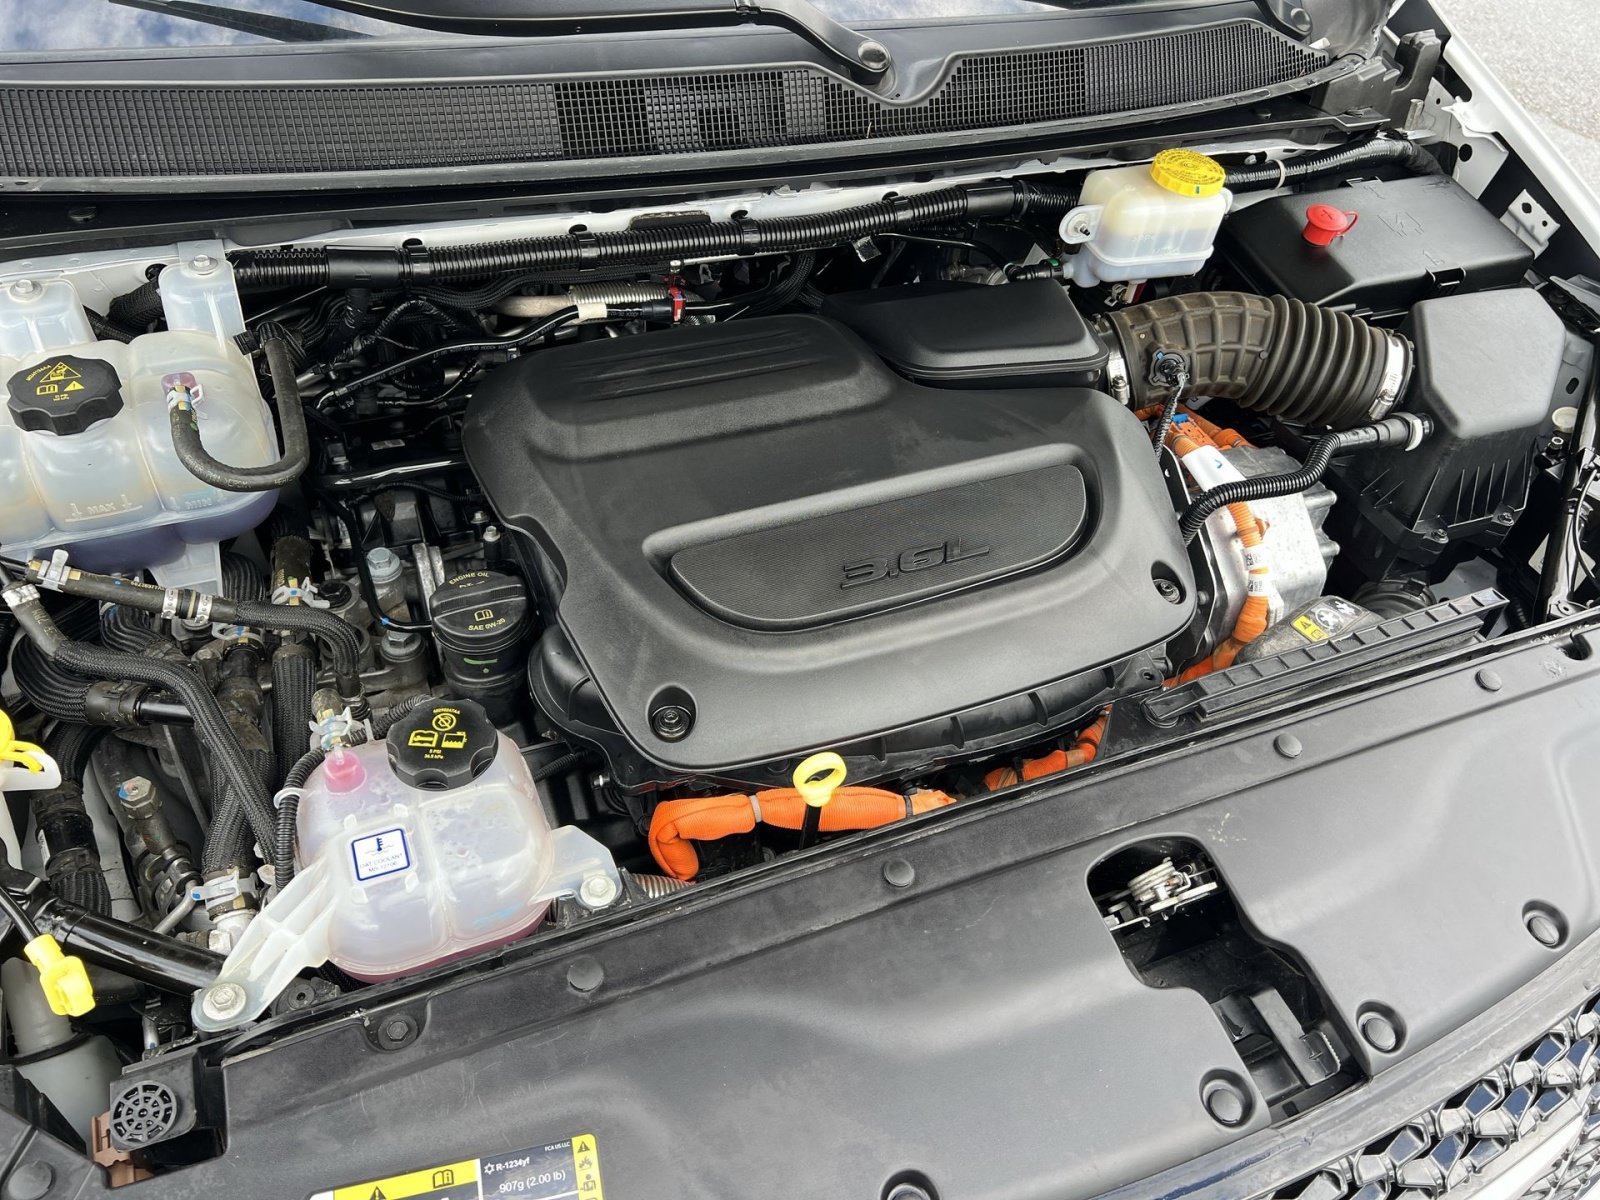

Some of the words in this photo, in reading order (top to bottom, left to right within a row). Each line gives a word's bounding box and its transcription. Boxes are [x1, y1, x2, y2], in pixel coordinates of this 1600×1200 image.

[87, 502, 116, 515] MAX
[840, 537, 990, 590] 3.6L
[449, 572, 475, 585] ENGINE
[485, 618, 506, 630] 0W-20
[374, 853, 403, 865] COOLANT
[495, 1157, 530, 1171] R-1234yf
[499, 1180, 525, 1193] 907g
[526, 1174, 551, 1187] (2.00
[552, 1169, 566, 1181] lb)
